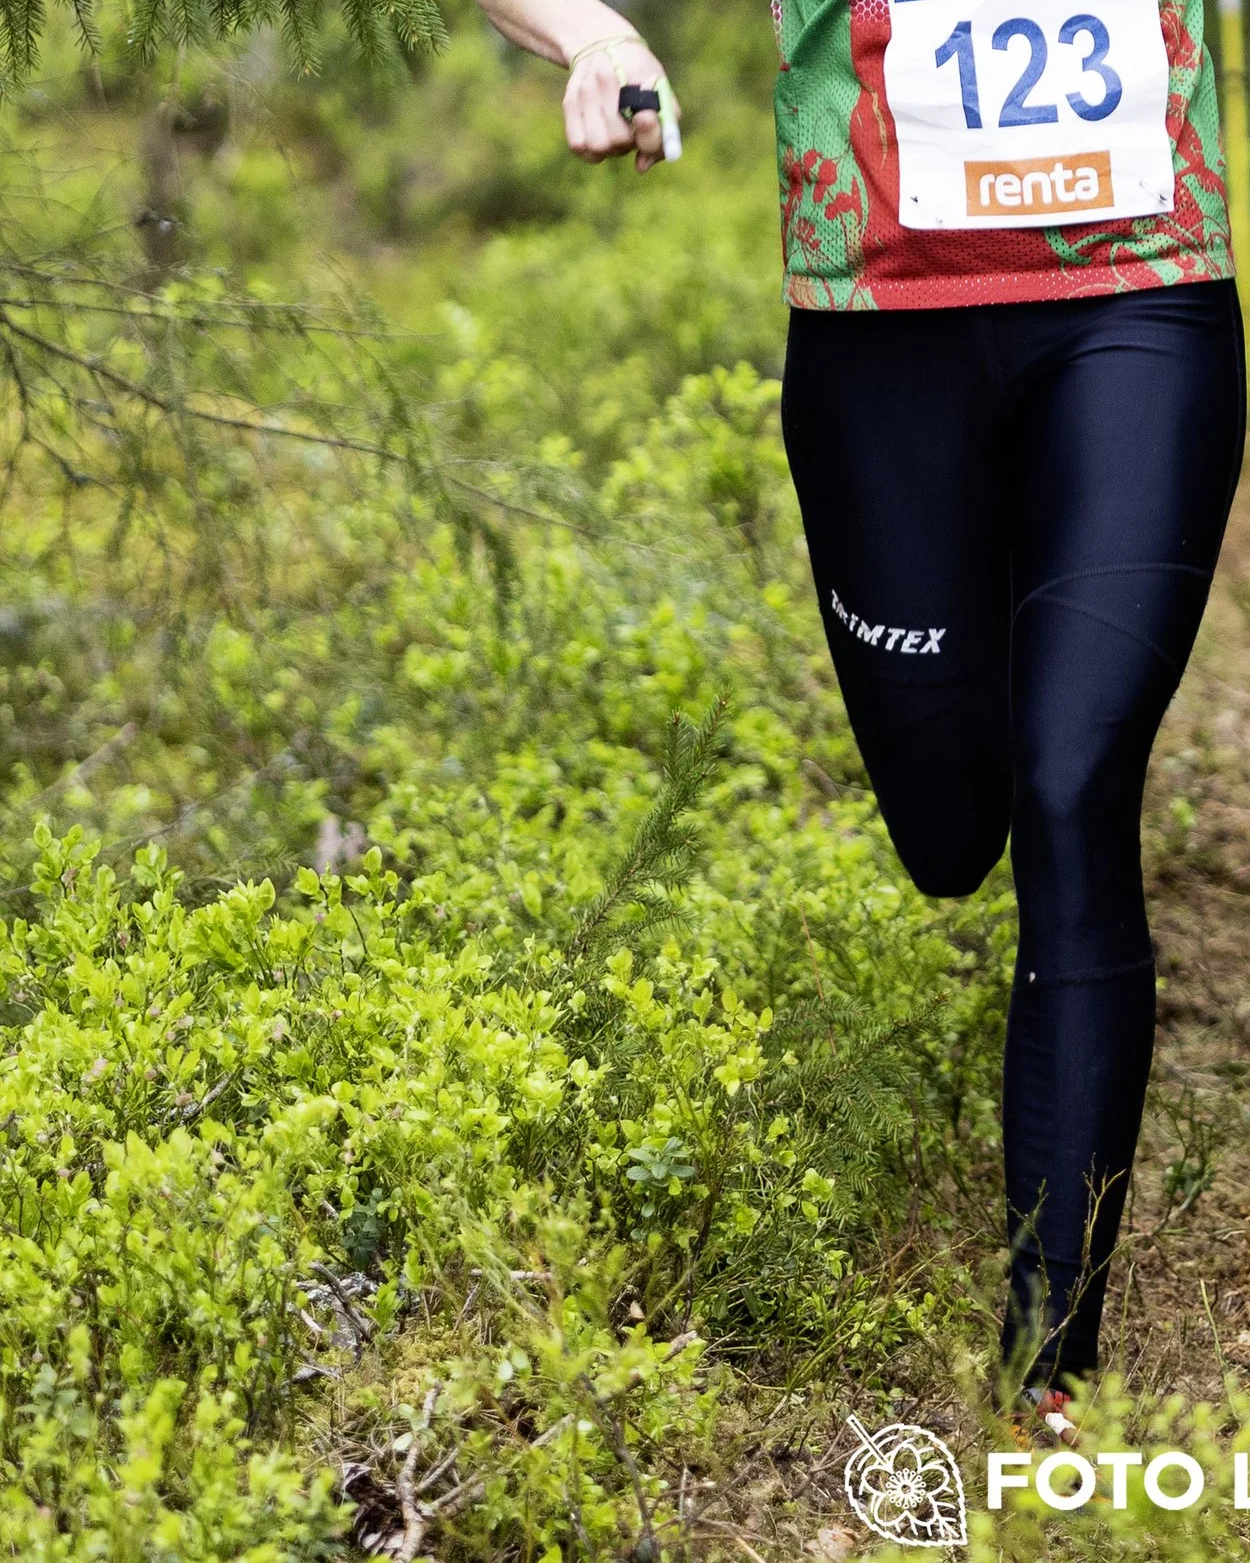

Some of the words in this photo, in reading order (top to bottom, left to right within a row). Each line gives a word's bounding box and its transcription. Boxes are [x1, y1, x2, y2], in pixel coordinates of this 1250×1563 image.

[935, 14, 1123, 129] 123
[979, 163, 1100, 207] renta
[831, 588, 947, 654] TRIMTEX
